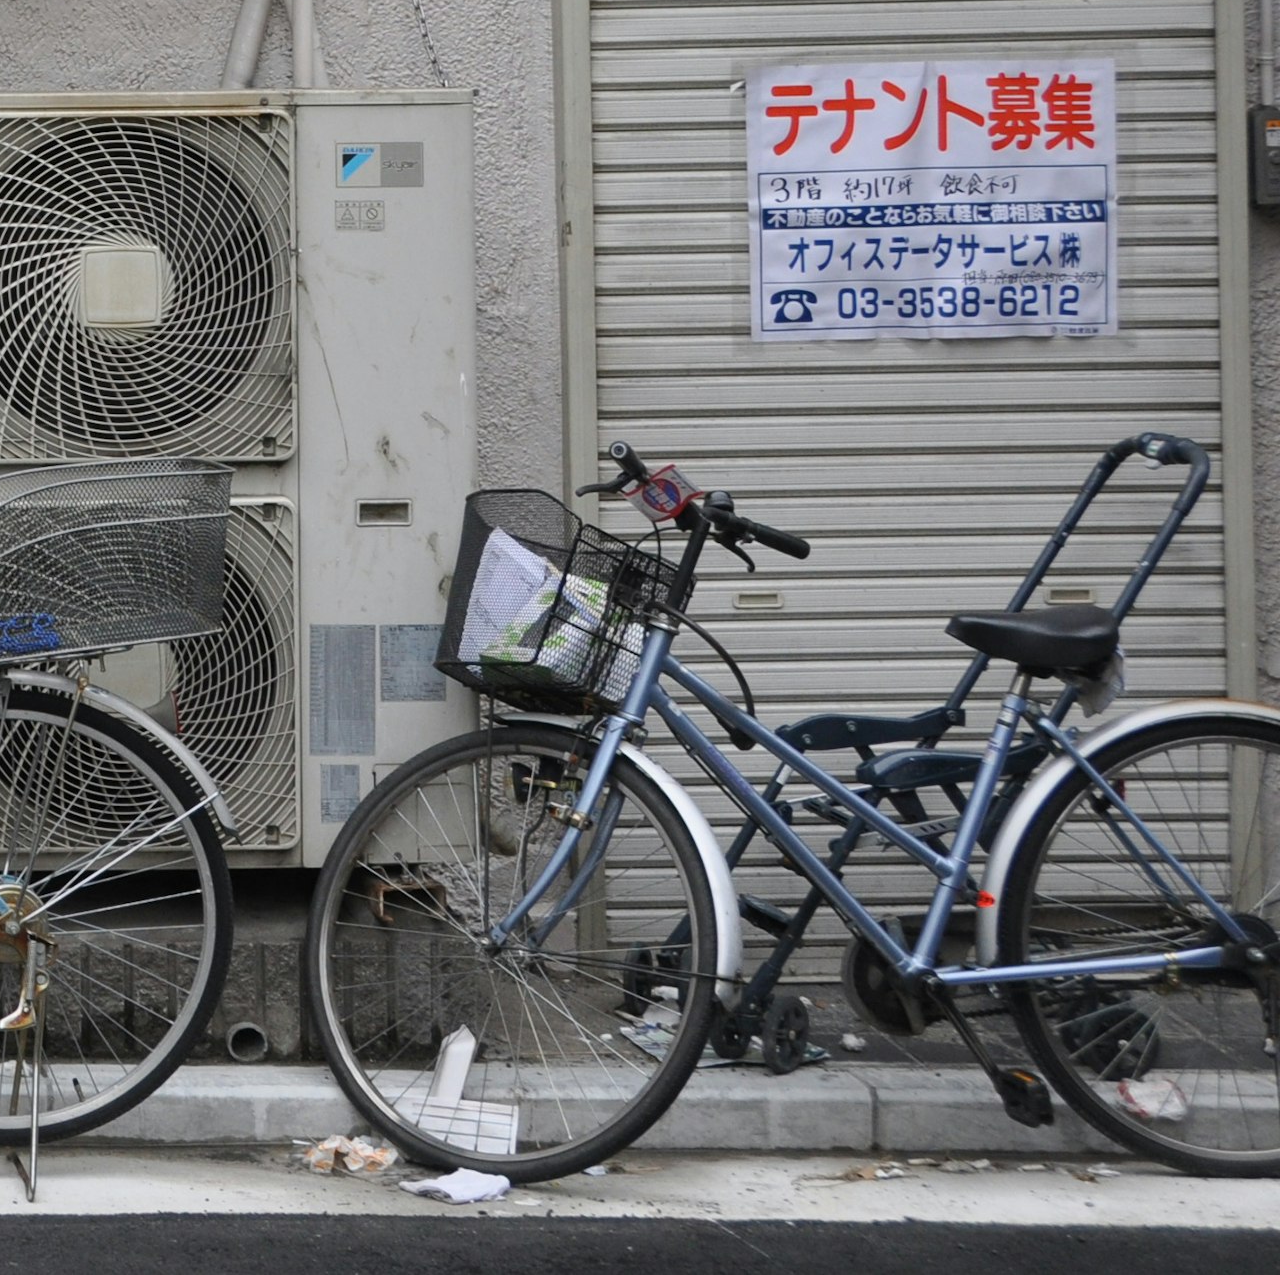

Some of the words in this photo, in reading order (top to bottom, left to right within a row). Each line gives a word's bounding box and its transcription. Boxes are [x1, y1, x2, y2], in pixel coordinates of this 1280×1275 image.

[765, 71, 1096, 156] テナント募集
[771, 178, 822, 203] 3階
[844, 175, 915, 202] 約17坪
[939, 173, 1021, 196] 飲食不可
[766, 203, 1102, 228] 不動産のことならお気軽に御相談下さい
[837, 284, 1080, 319] 03-3538-6212
